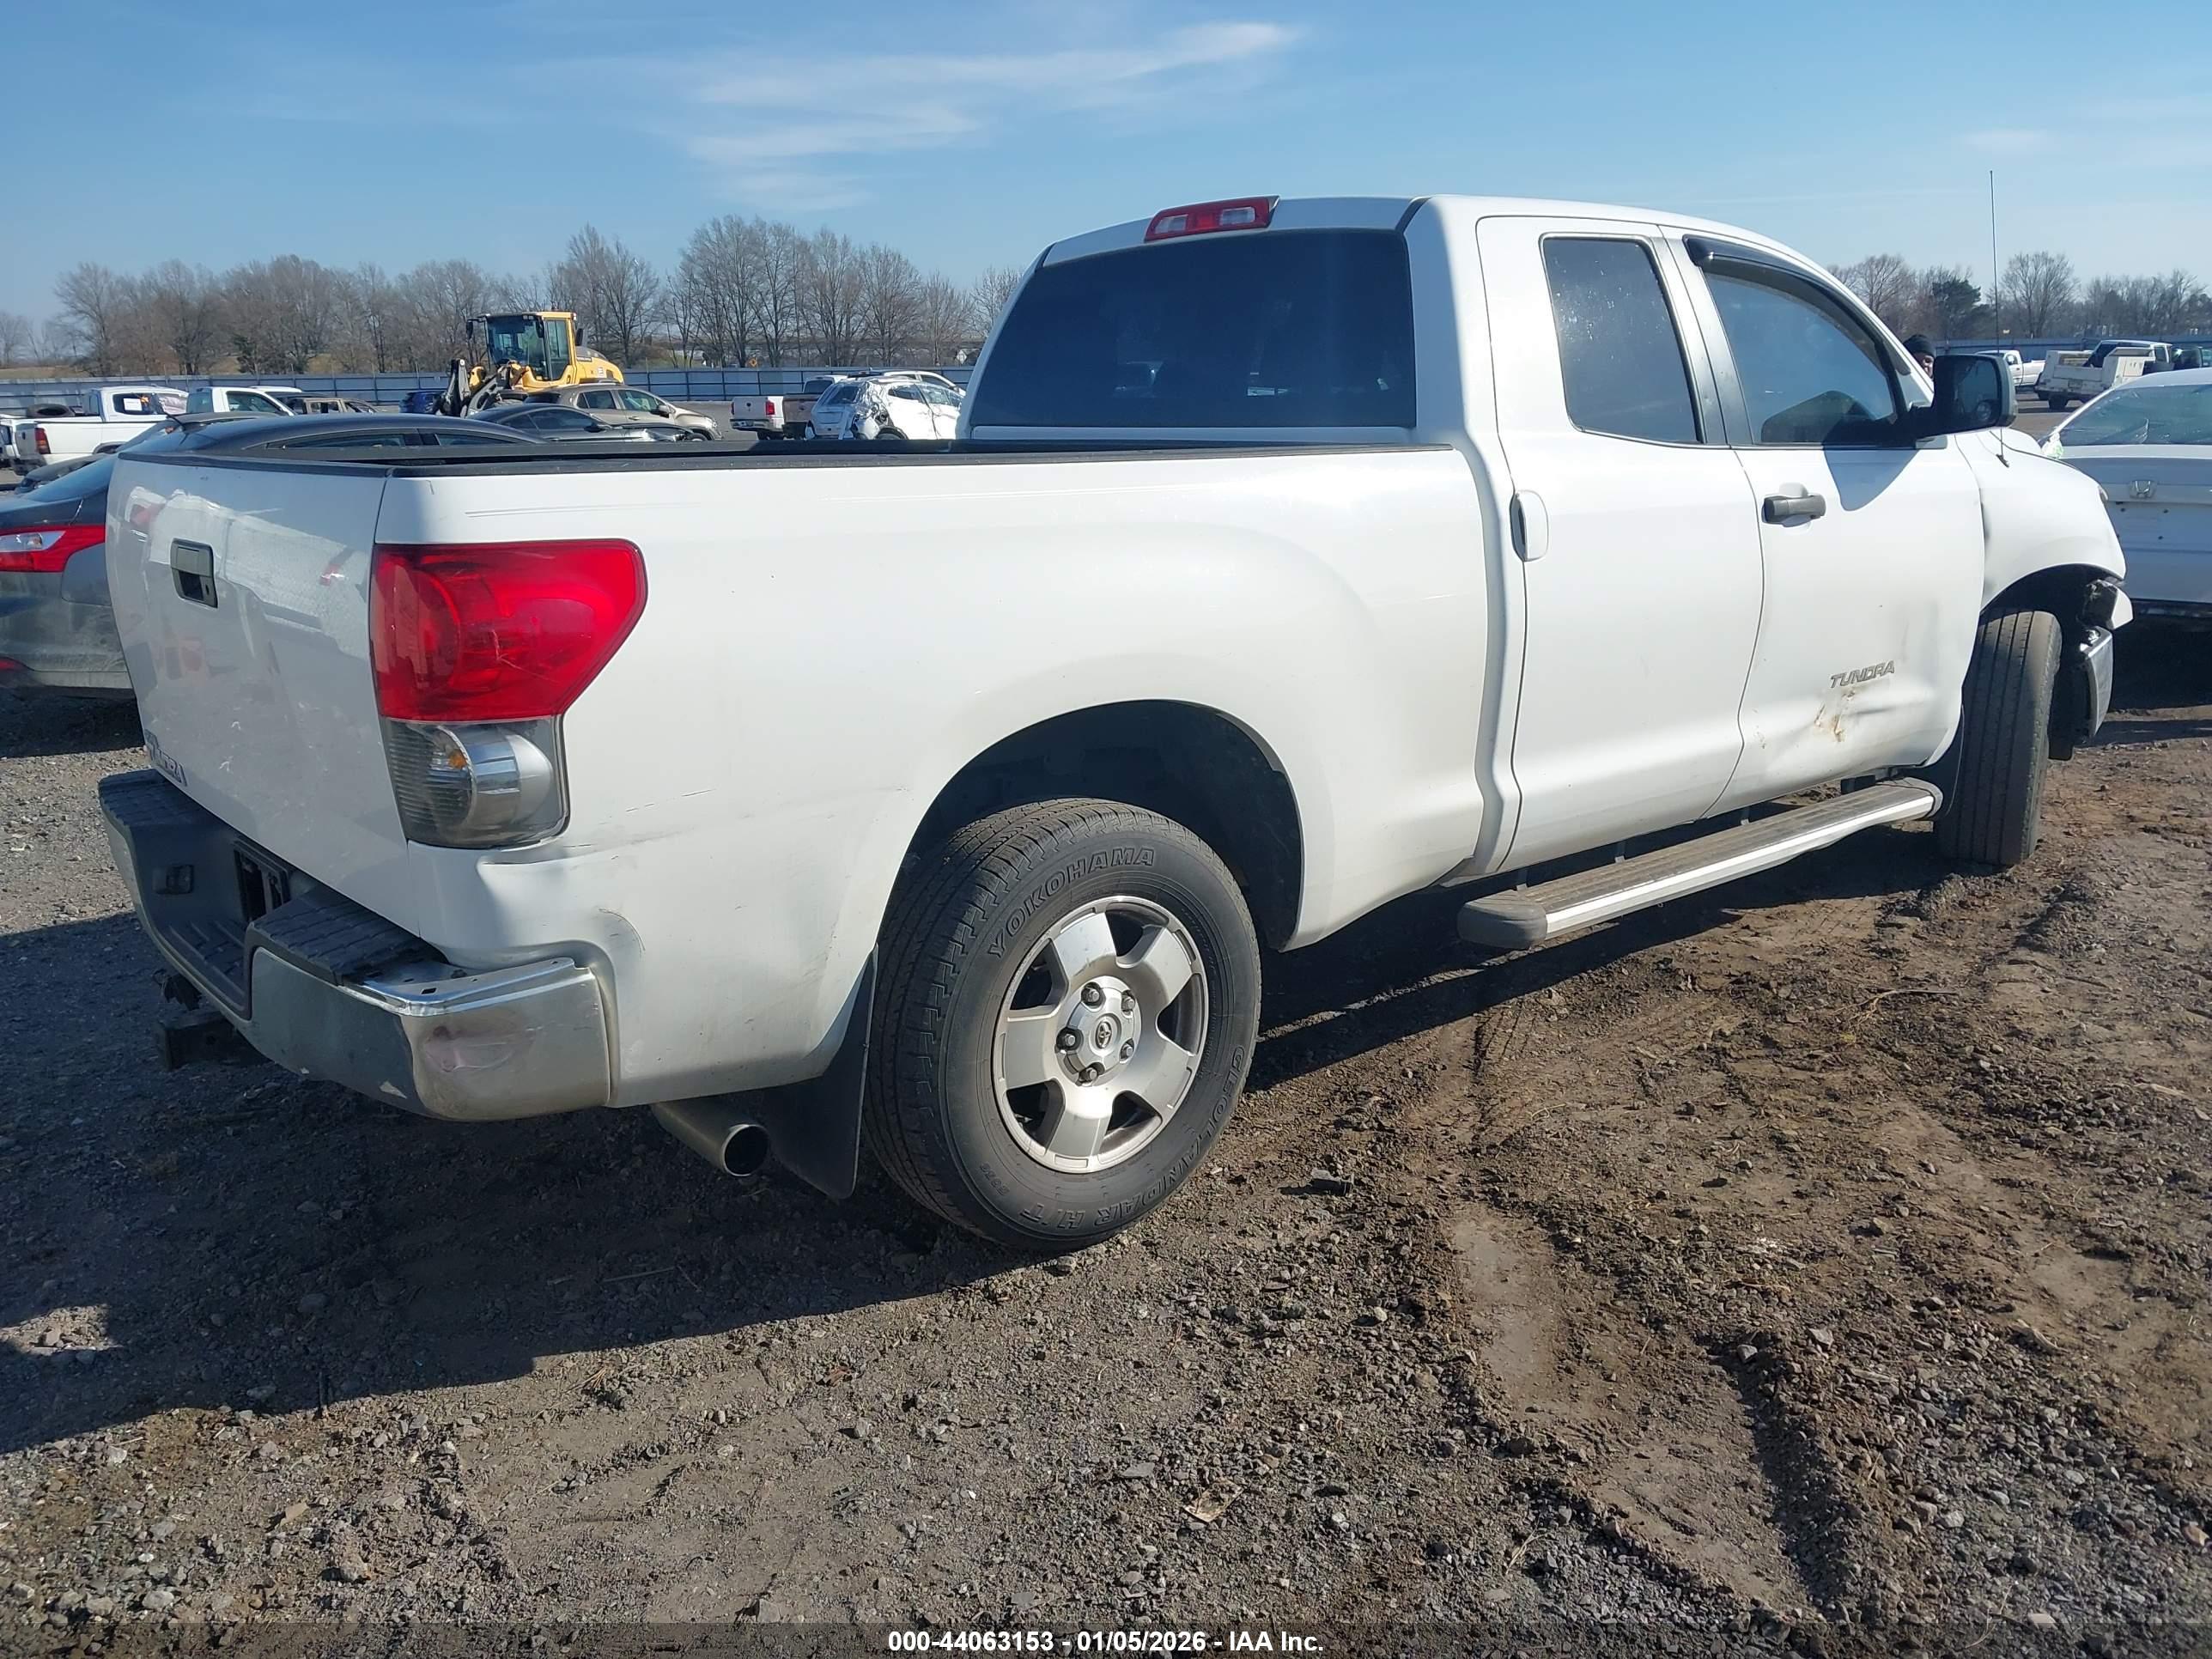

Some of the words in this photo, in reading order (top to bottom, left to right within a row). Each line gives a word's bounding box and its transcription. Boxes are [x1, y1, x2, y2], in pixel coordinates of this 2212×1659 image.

[1830, 659, 1895, 689] TUNDRA
[988, 847, 1155, 959] YOKOHAMA
[1093, 1045, 1246, 1227] GEOLANDAR
